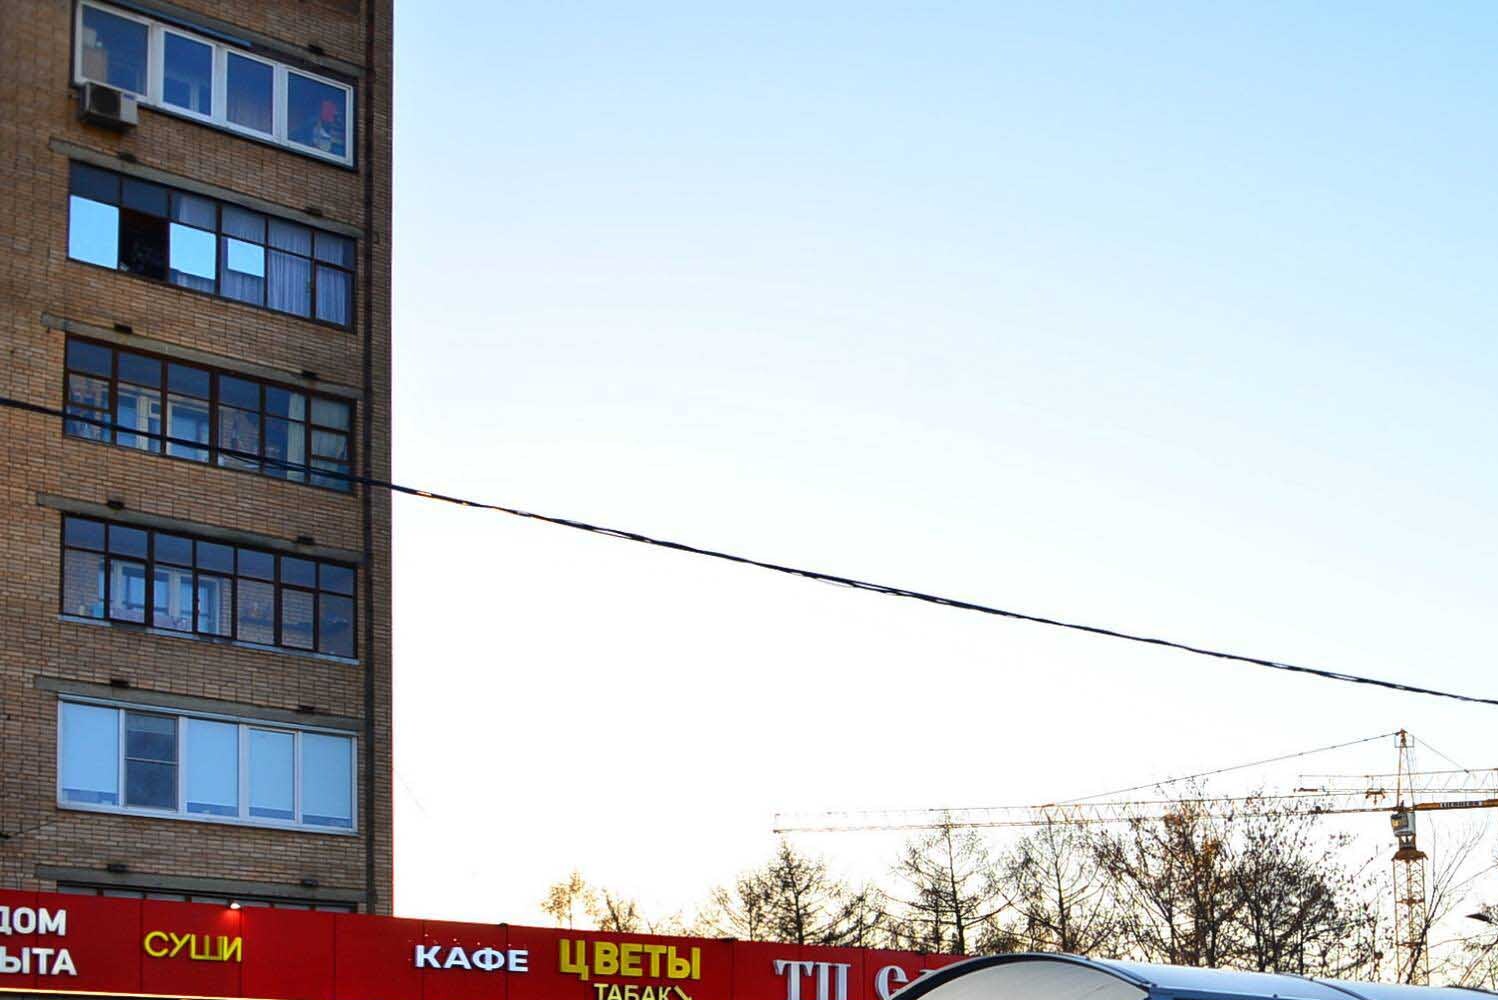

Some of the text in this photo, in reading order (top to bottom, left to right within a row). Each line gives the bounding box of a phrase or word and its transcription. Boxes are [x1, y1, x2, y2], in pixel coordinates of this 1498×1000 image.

[144, 930, 242, 962] СУШИ
[415, 944, 529, 972] КАФЕ
[559, 939, 701, 981] ЦВЕТЫ
